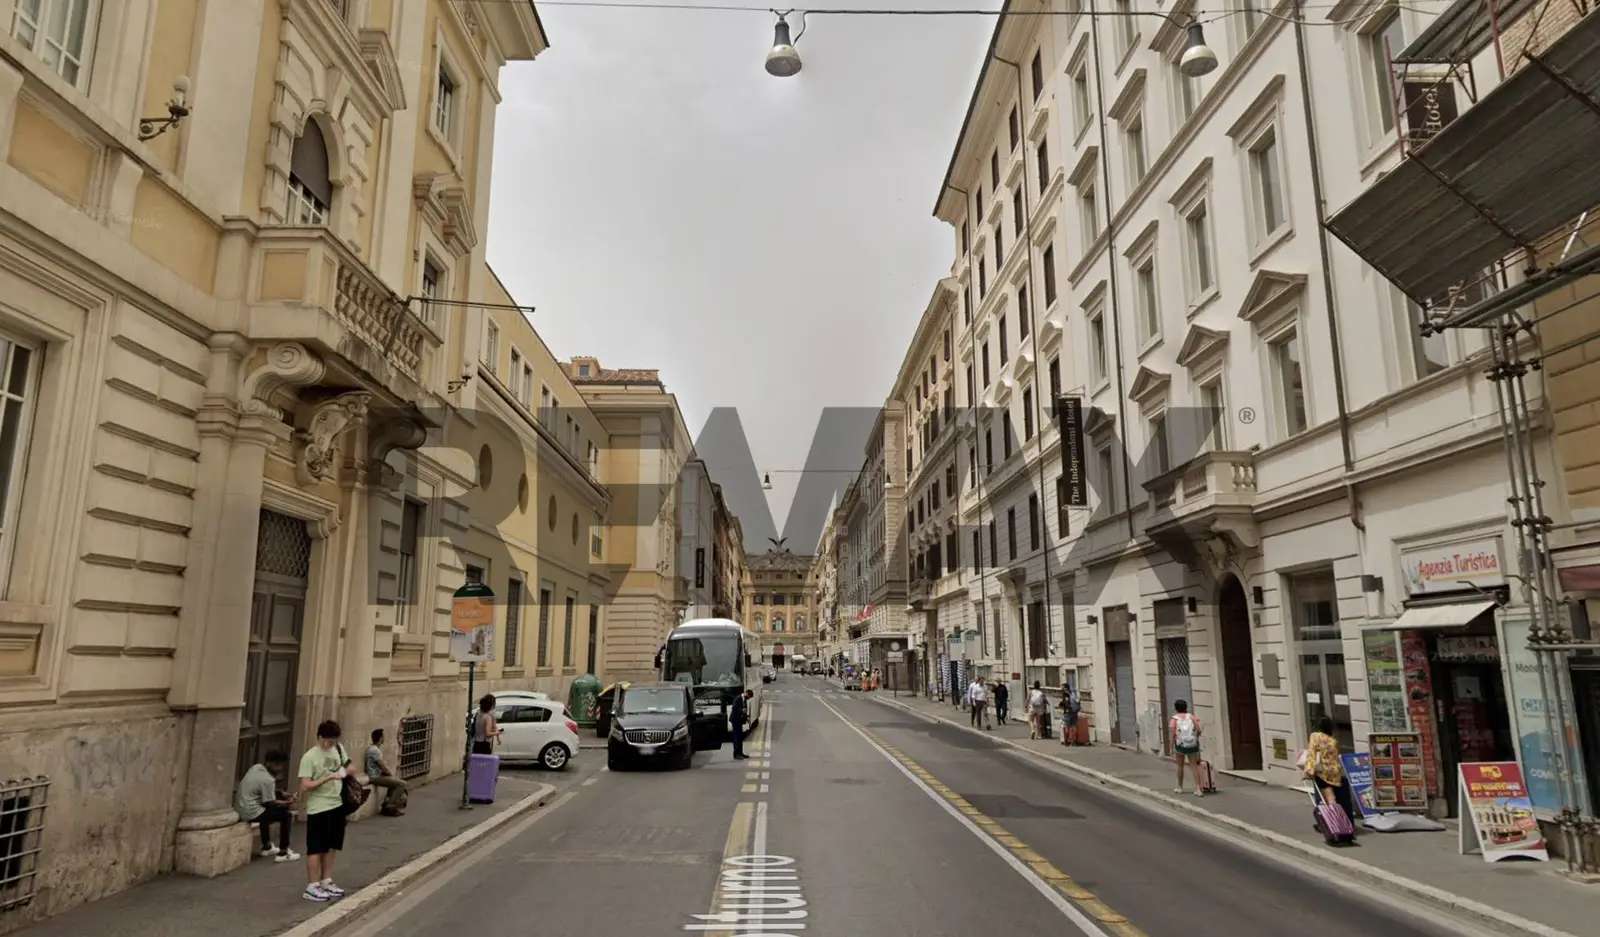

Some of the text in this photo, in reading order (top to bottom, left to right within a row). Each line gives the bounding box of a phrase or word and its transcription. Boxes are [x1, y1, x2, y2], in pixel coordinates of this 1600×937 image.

[1422, 88, 1442, 133] Hotel
[1065, 400, 1080, 505] The Independent Hotel
[1418, 552, 1498, 581] Agenzia Turistica
[683, 855, 808, 937] lturno
